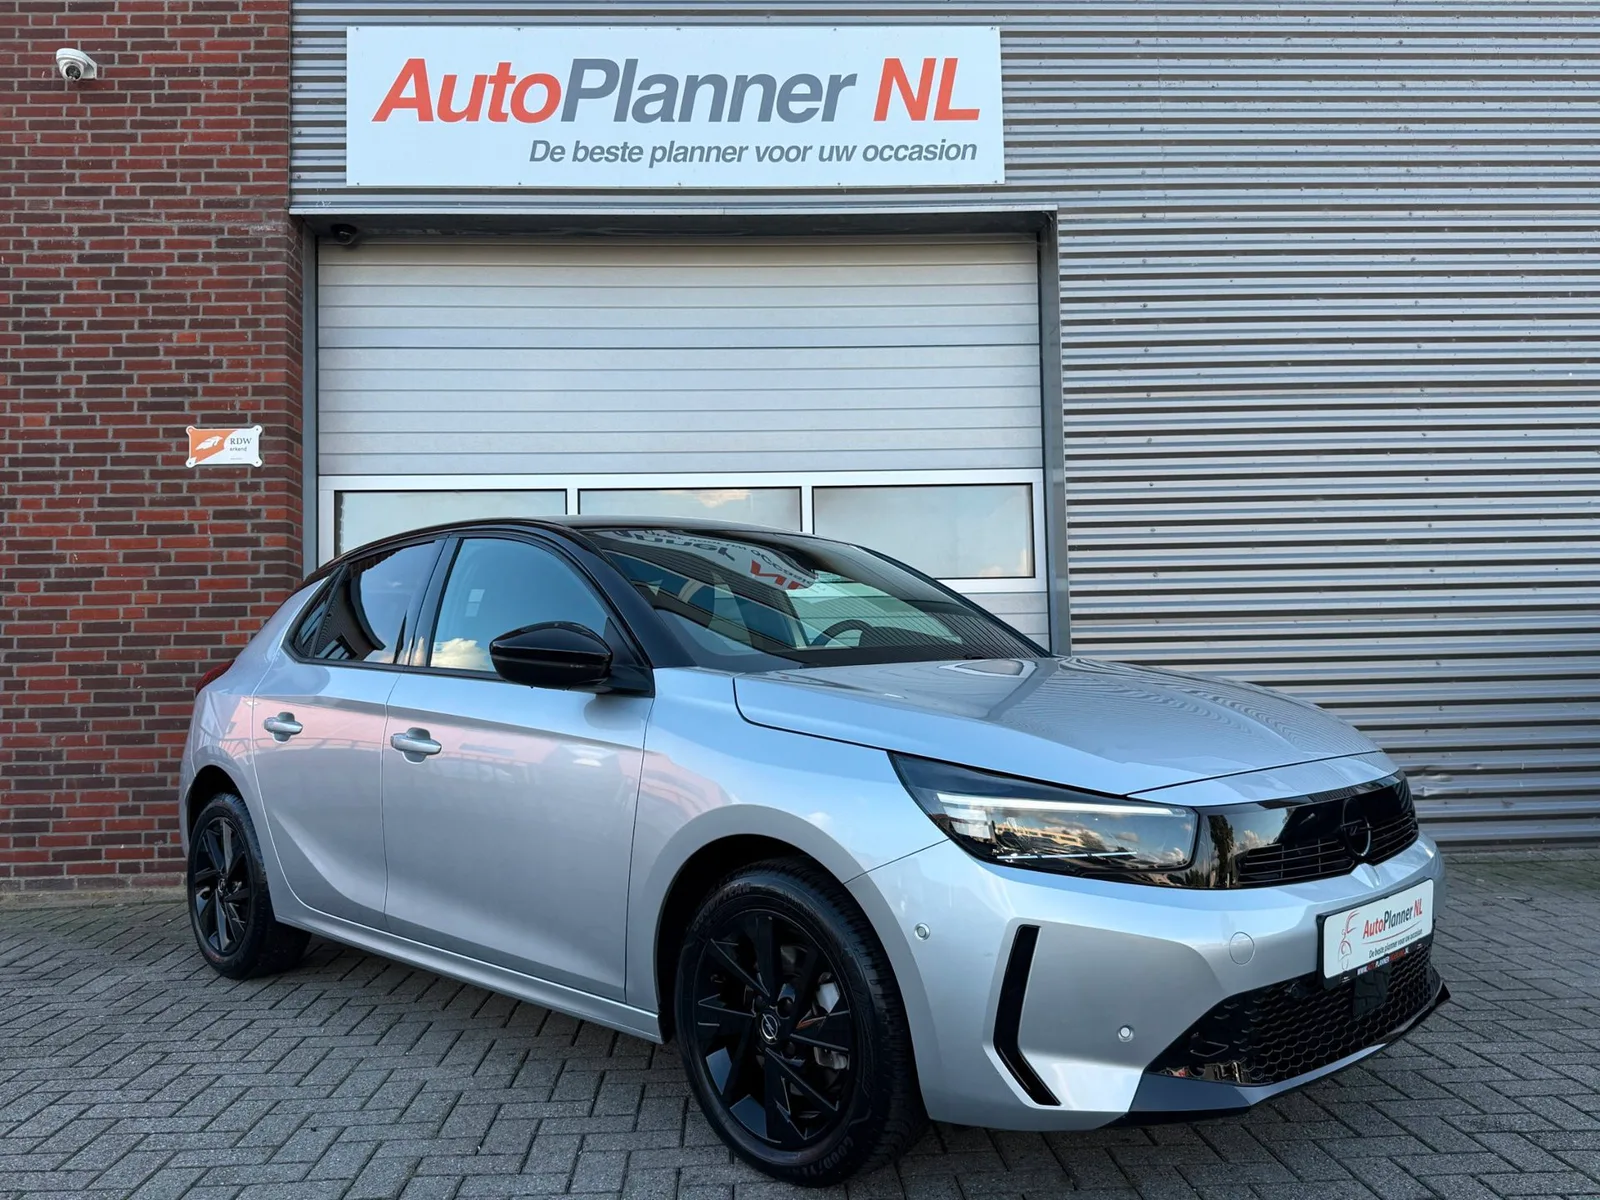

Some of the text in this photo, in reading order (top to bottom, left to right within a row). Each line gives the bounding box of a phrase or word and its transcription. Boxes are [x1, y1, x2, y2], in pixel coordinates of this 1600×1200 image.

[372, 57, 981, 124] AutoPlanner NL
[529, 138, 978, 169] De beste planner voor uw occasion
[230, 437, 252, 445] RDW
[1362, 898, 1423, 939] AutoPlanner NL
